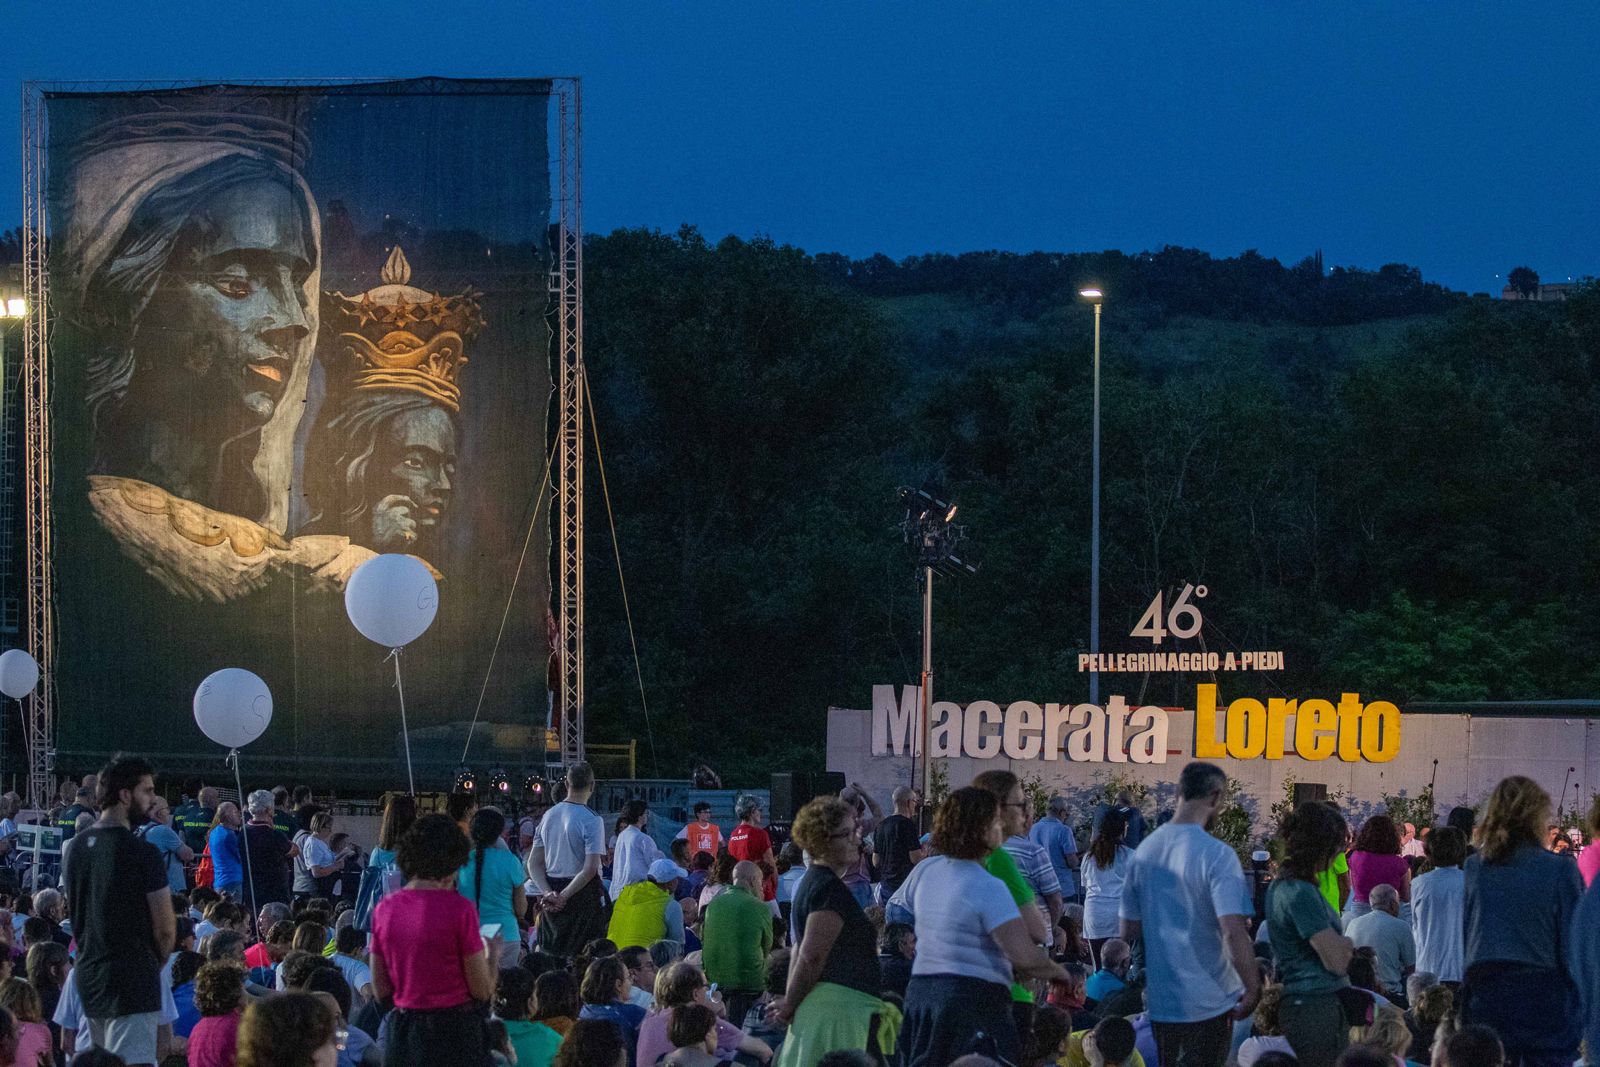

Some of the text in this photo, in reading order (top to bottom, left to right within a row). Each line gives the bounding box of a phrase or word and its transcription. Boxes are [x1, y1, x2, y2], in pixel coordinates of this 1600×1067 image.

[1129, 582, 1209, 645] 46°
[1078, 651, 1285, 673] PELLEGRINAGGIO A PIEDI
[871, 683, 1401, 764] Macerata Loreto
